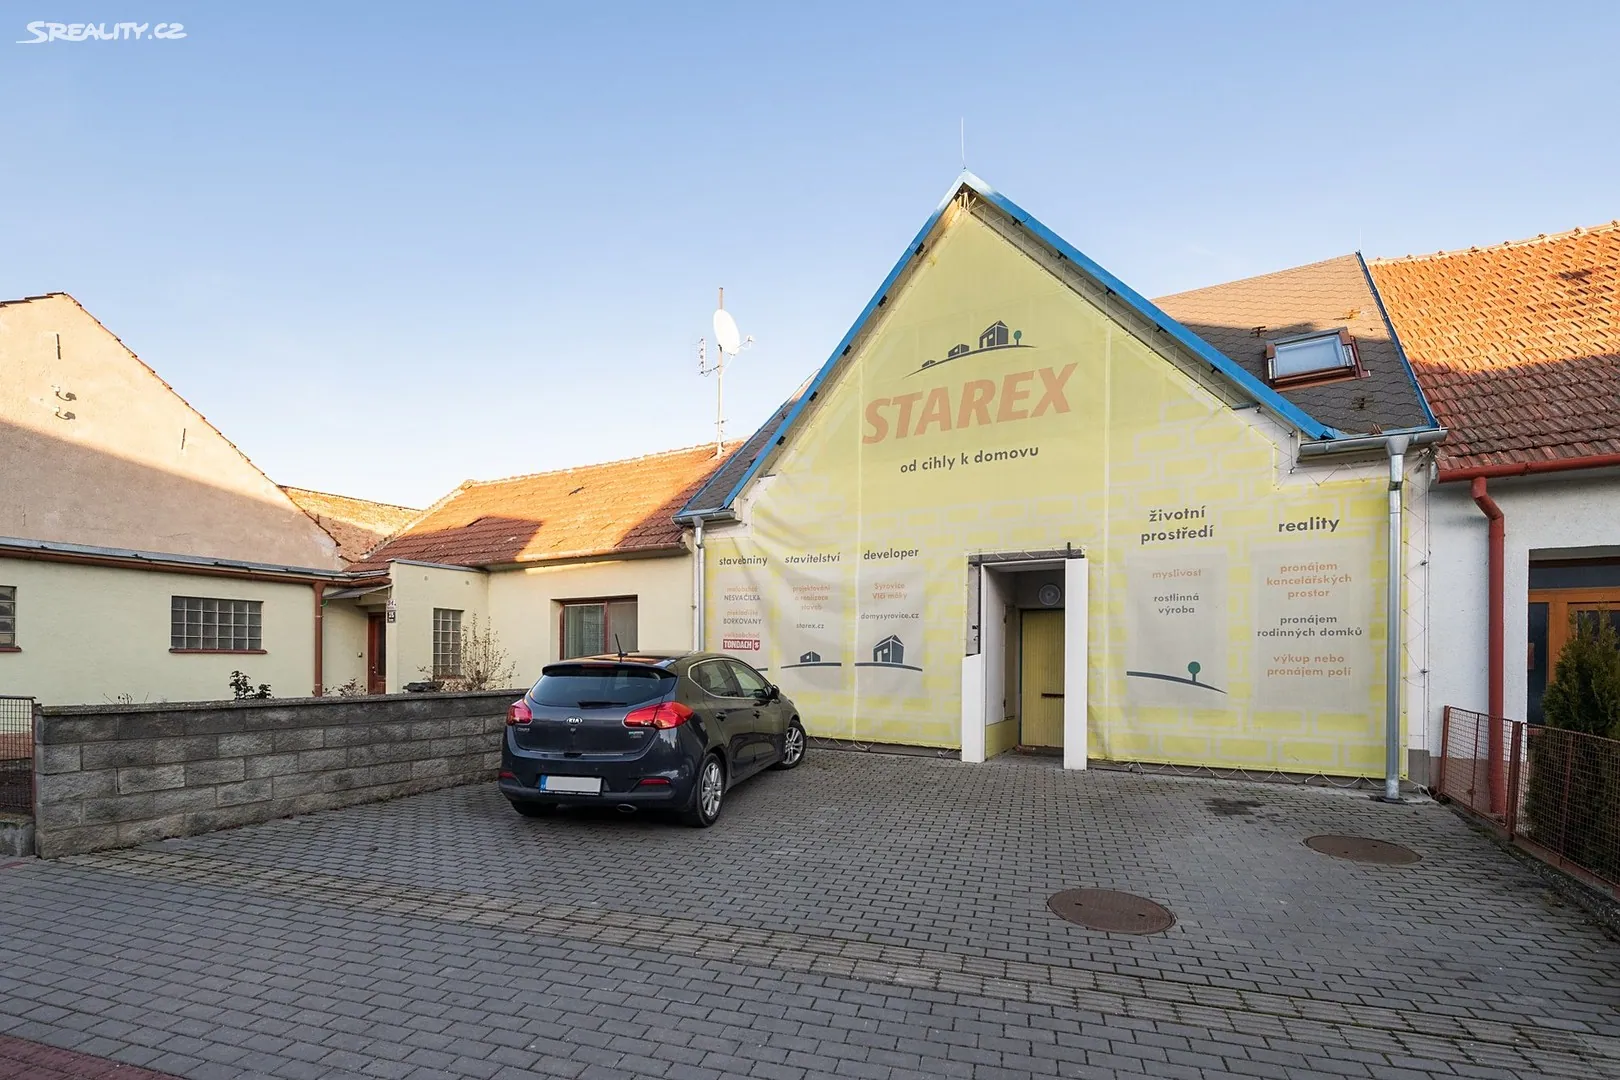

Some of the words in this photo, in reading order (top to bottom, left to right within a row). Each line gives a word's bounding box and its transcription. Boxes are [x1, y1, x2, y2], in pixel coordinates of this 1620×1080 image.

[861, 362, 1078, 445] STAREX
[900, 459, 917, 473] od
[922, 455, 955, 470] cihly
[960, 452, 969, 465] k
[974, 446, 1039, 464] domovu
[1149, 505, 1206, 522] životní
[1278, 516, 1340, 533] reality
[1141, 524, 1215, 545] prostředí
[784, 551, 841, 564] stavitelství
[863, 547, 920, 560] developer
[719, 555, 768, 567] stavebniny
[1152, 568, 1202, 579] myslivost
[1280, 561, 1338, 574] pronájem
[874, 581, 905, 590] Syrovice
[1266, 574, 1352, 586] kancelářských
[1153, 592, 1200, 602] rostlinná
[1287, 589, 1331, 600] prostor
[860, 611, 920, 620] domysyrovice.cz
[1158, 604, 1195, 616] výroba
[796, 622, 825, 630] starex.cz
[1280, 614, 1338, 626] pronájem
[1257, 627, 1316, 639] rodinných
[1320, 626, 1363, 637] domků
[723, 640, 752, 649] TONDACH
[1273, 653, 1310, 665] výkup
[1314, 653, 1345, 663] nebo
[1267, 666, 1324, 678] pronájem
